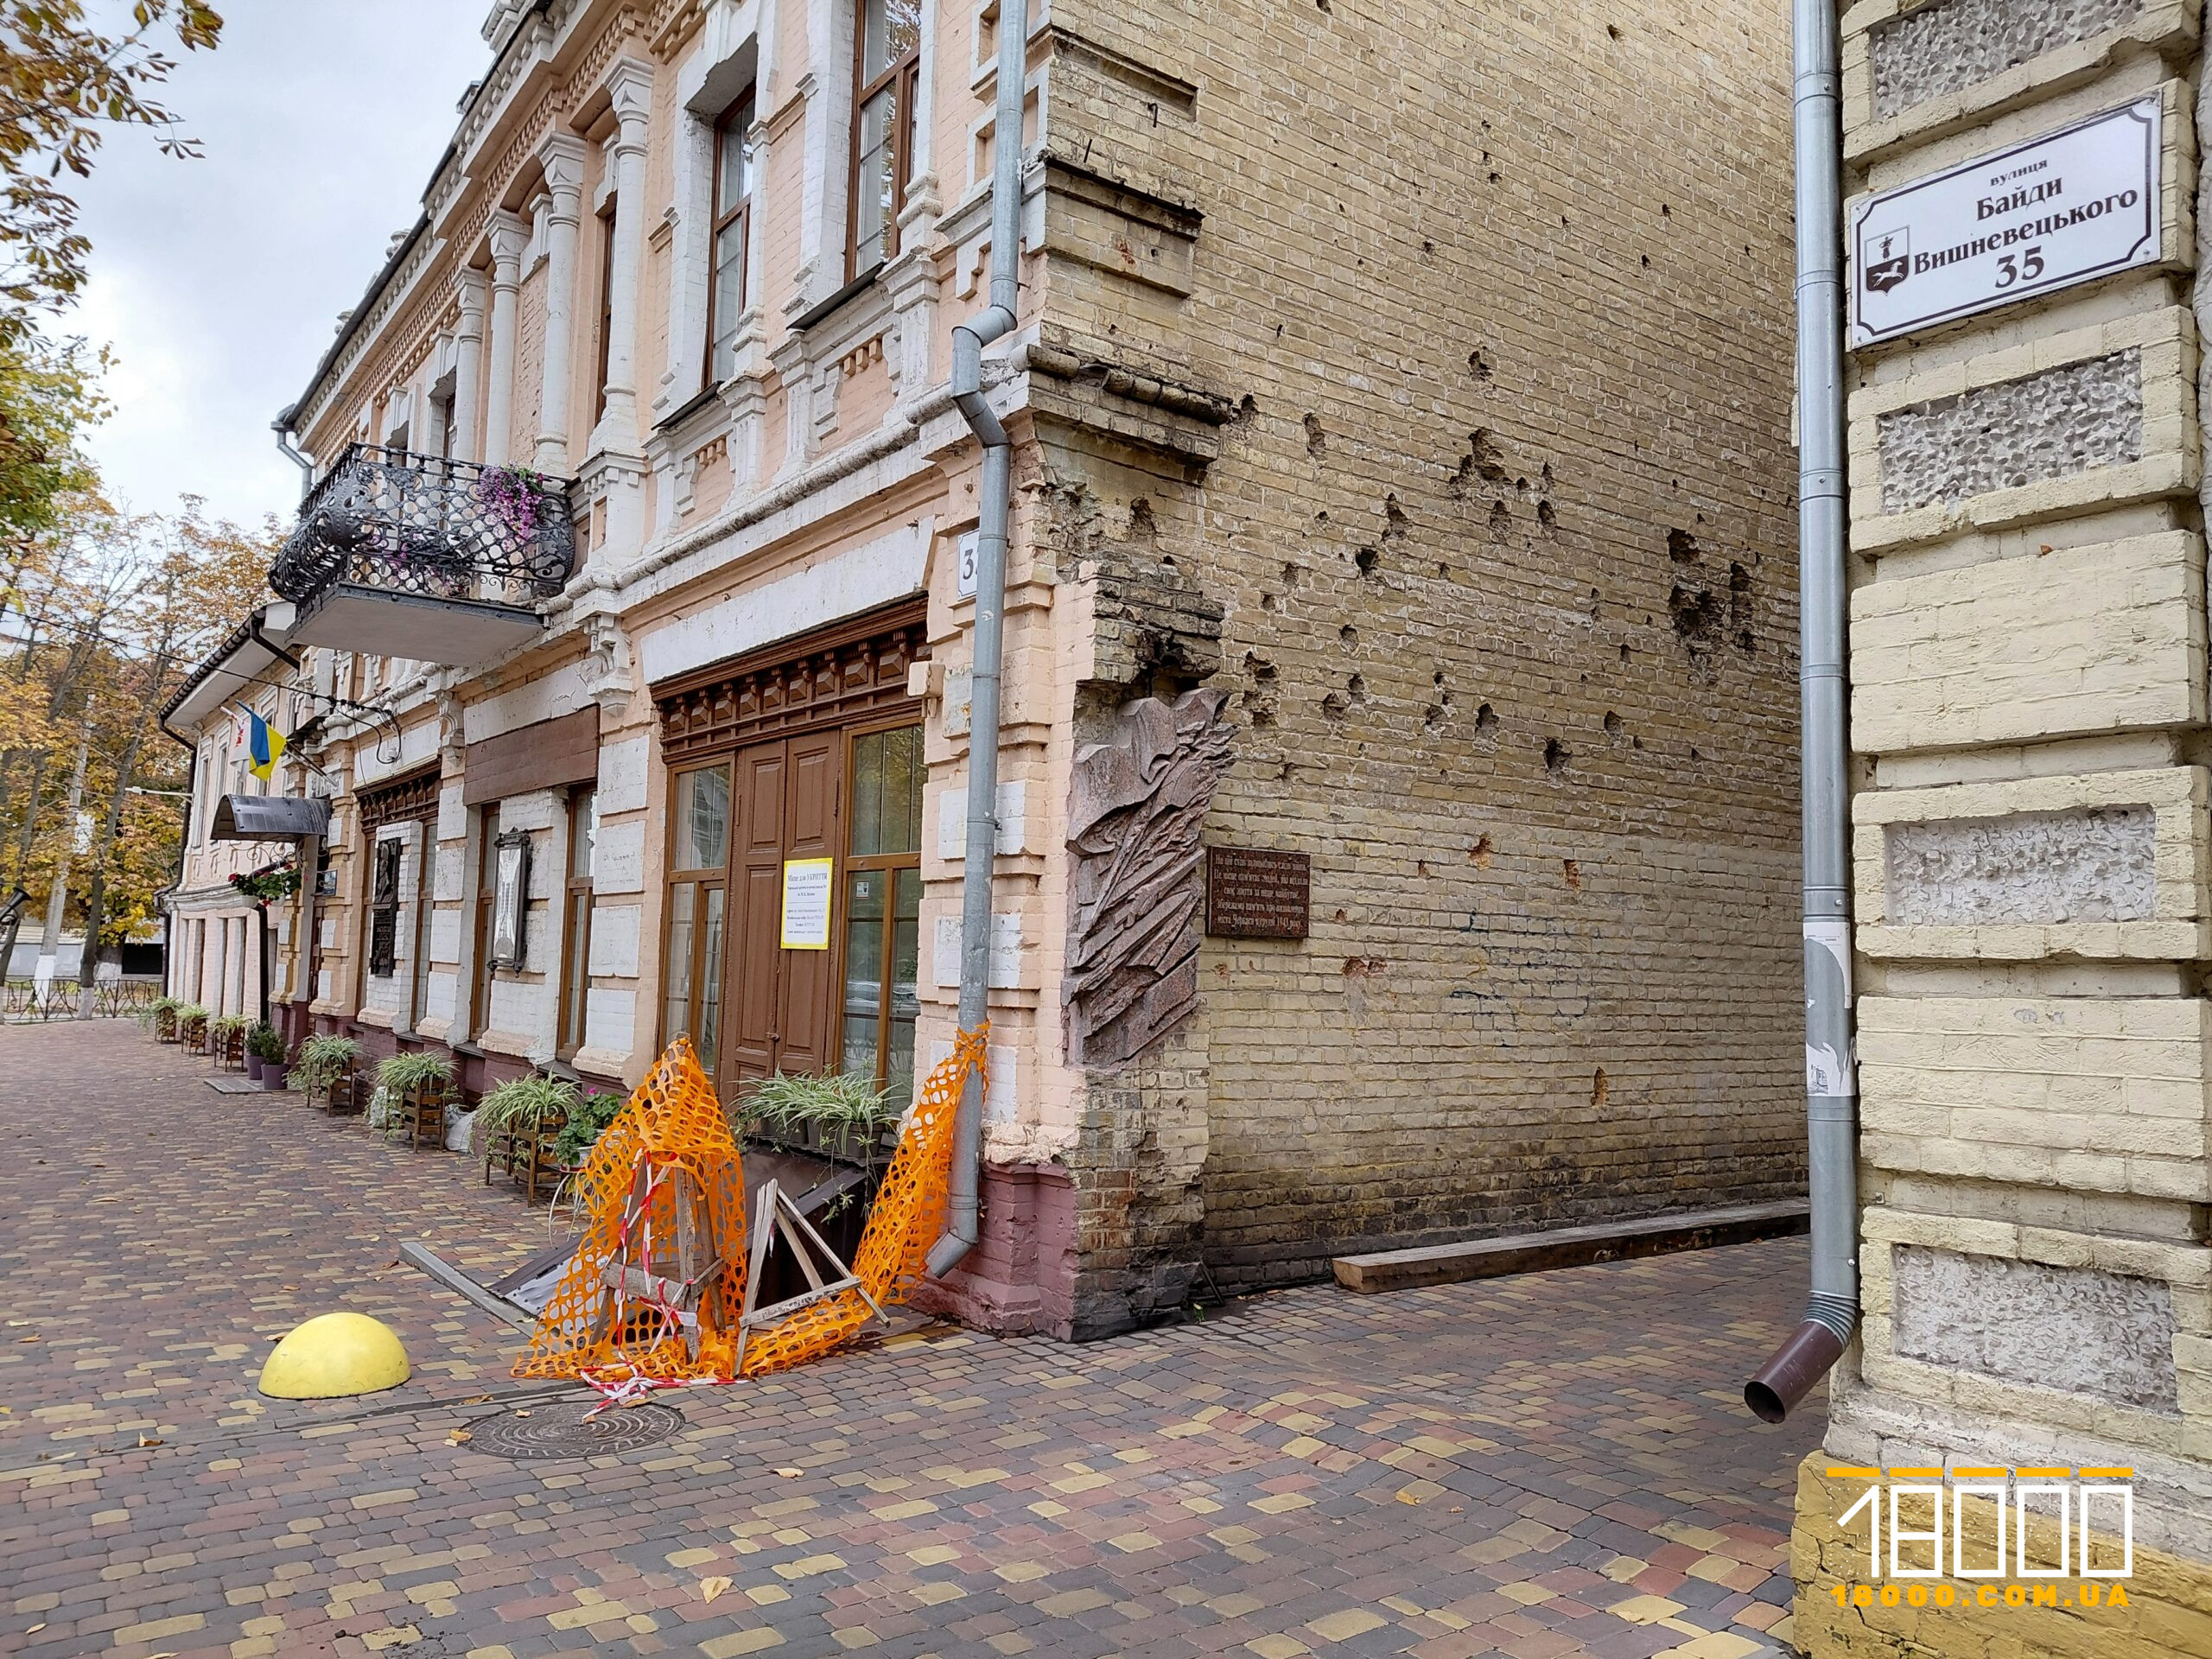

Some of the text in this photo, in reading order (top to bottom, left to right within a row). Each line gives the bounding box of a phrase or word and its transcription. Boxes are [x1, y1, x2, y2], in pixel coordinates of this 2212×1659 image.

[1990, 159, 2048, 187] вулиця
[1976, 176, 2063, 220] Байди
[1914, 188, 2138, 275] Вишневецького
[1995, 245, 2044, 289] 35
[963, 548, 978, 580] 3
[806, 873, 828, 881] УКРИТТЯ
